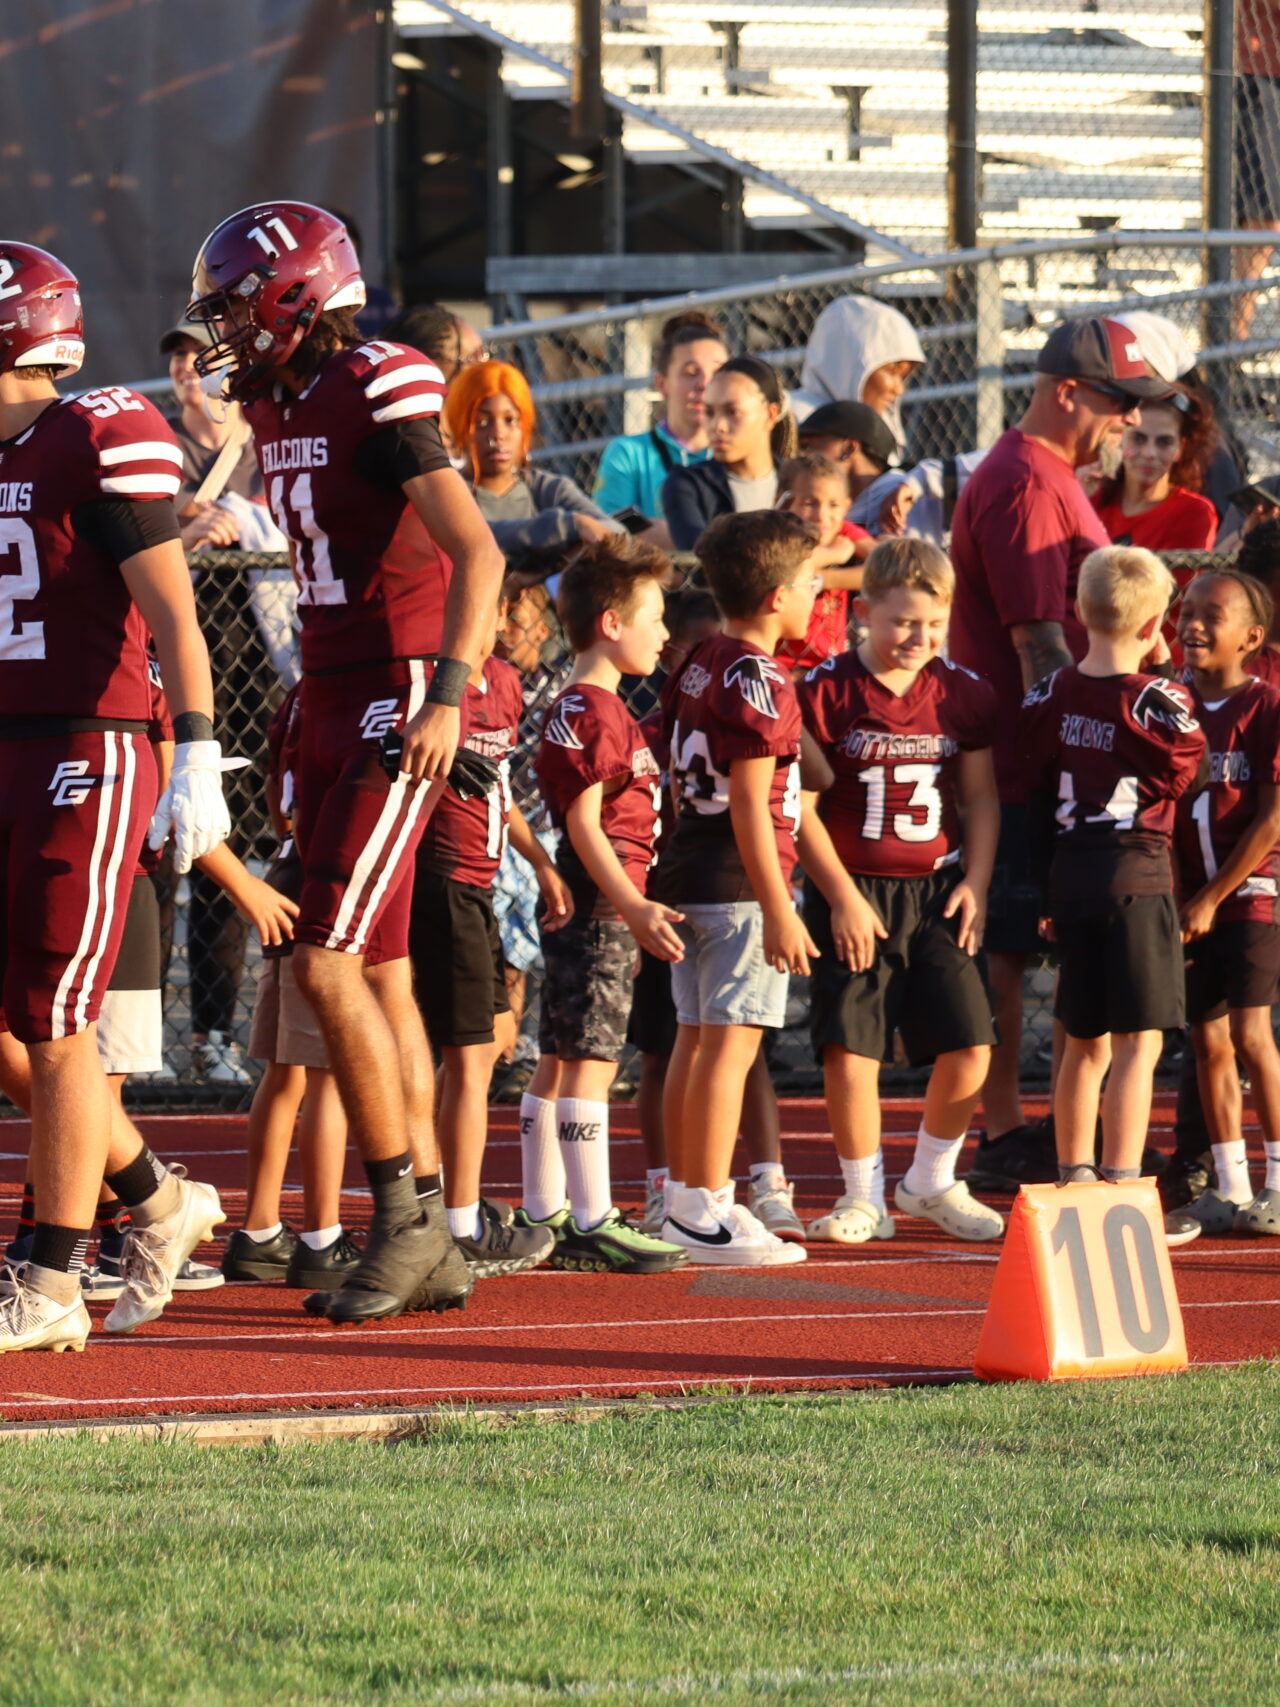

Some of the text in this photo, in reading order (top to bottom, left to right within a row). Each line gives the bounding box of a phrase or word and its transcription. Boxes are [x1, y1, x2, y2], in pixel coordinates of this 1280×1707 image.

[247, 216, 299, 259] 11
[353, 340, 406, 366] 11
[77, 387, 146, 418] 52
[261, 436, 328, 475] FALCONS
[270, 472, 348, 606] 11
[47, 760, 96, 806] PG
[857, 763, 942, 842] 13
[560, 1121, 601, 1142] NIKE
[1050, 1203, 1170, 1358] 10
